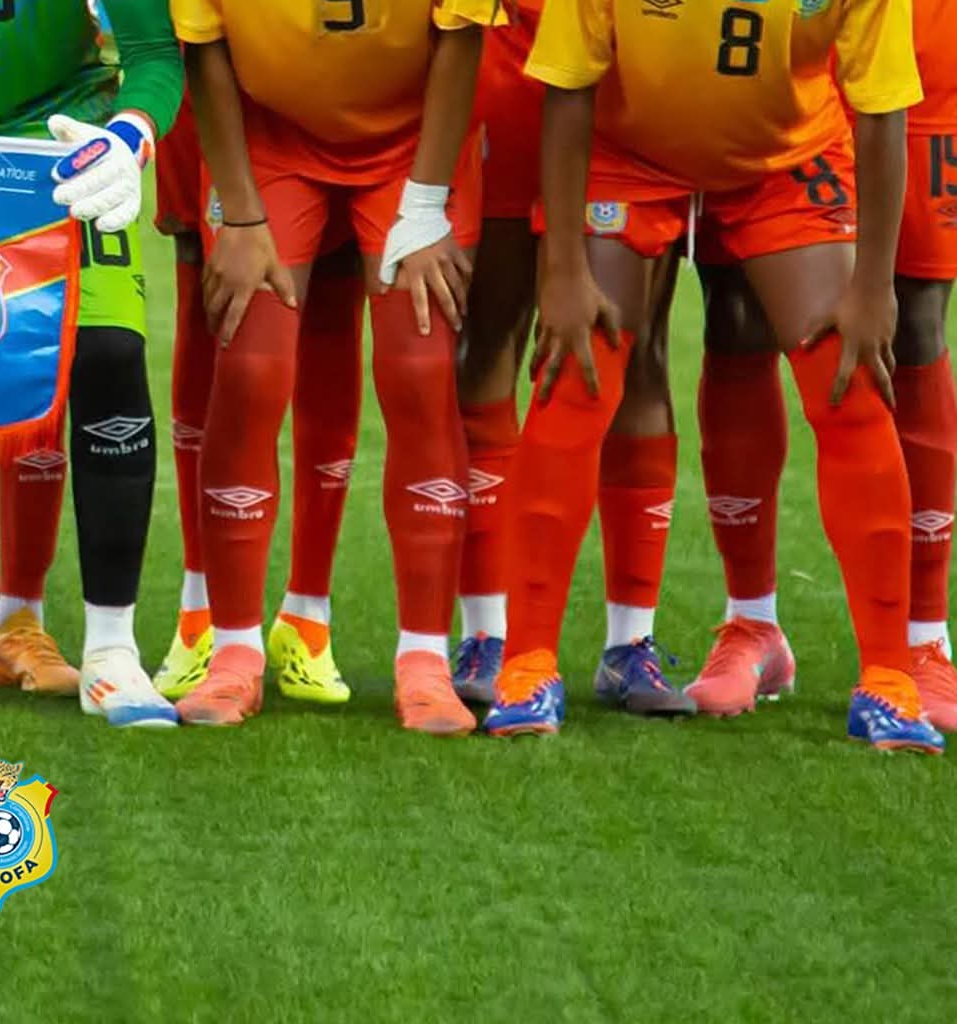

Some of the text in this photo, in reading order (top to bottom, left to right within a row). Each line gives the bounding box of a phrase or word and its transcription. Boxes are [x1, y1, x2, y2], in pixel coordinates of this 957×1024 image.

[716, 7, 763, 77] 8
[90, 437, 149, 456] umbro
[210, 507, 264, 520] umbro
